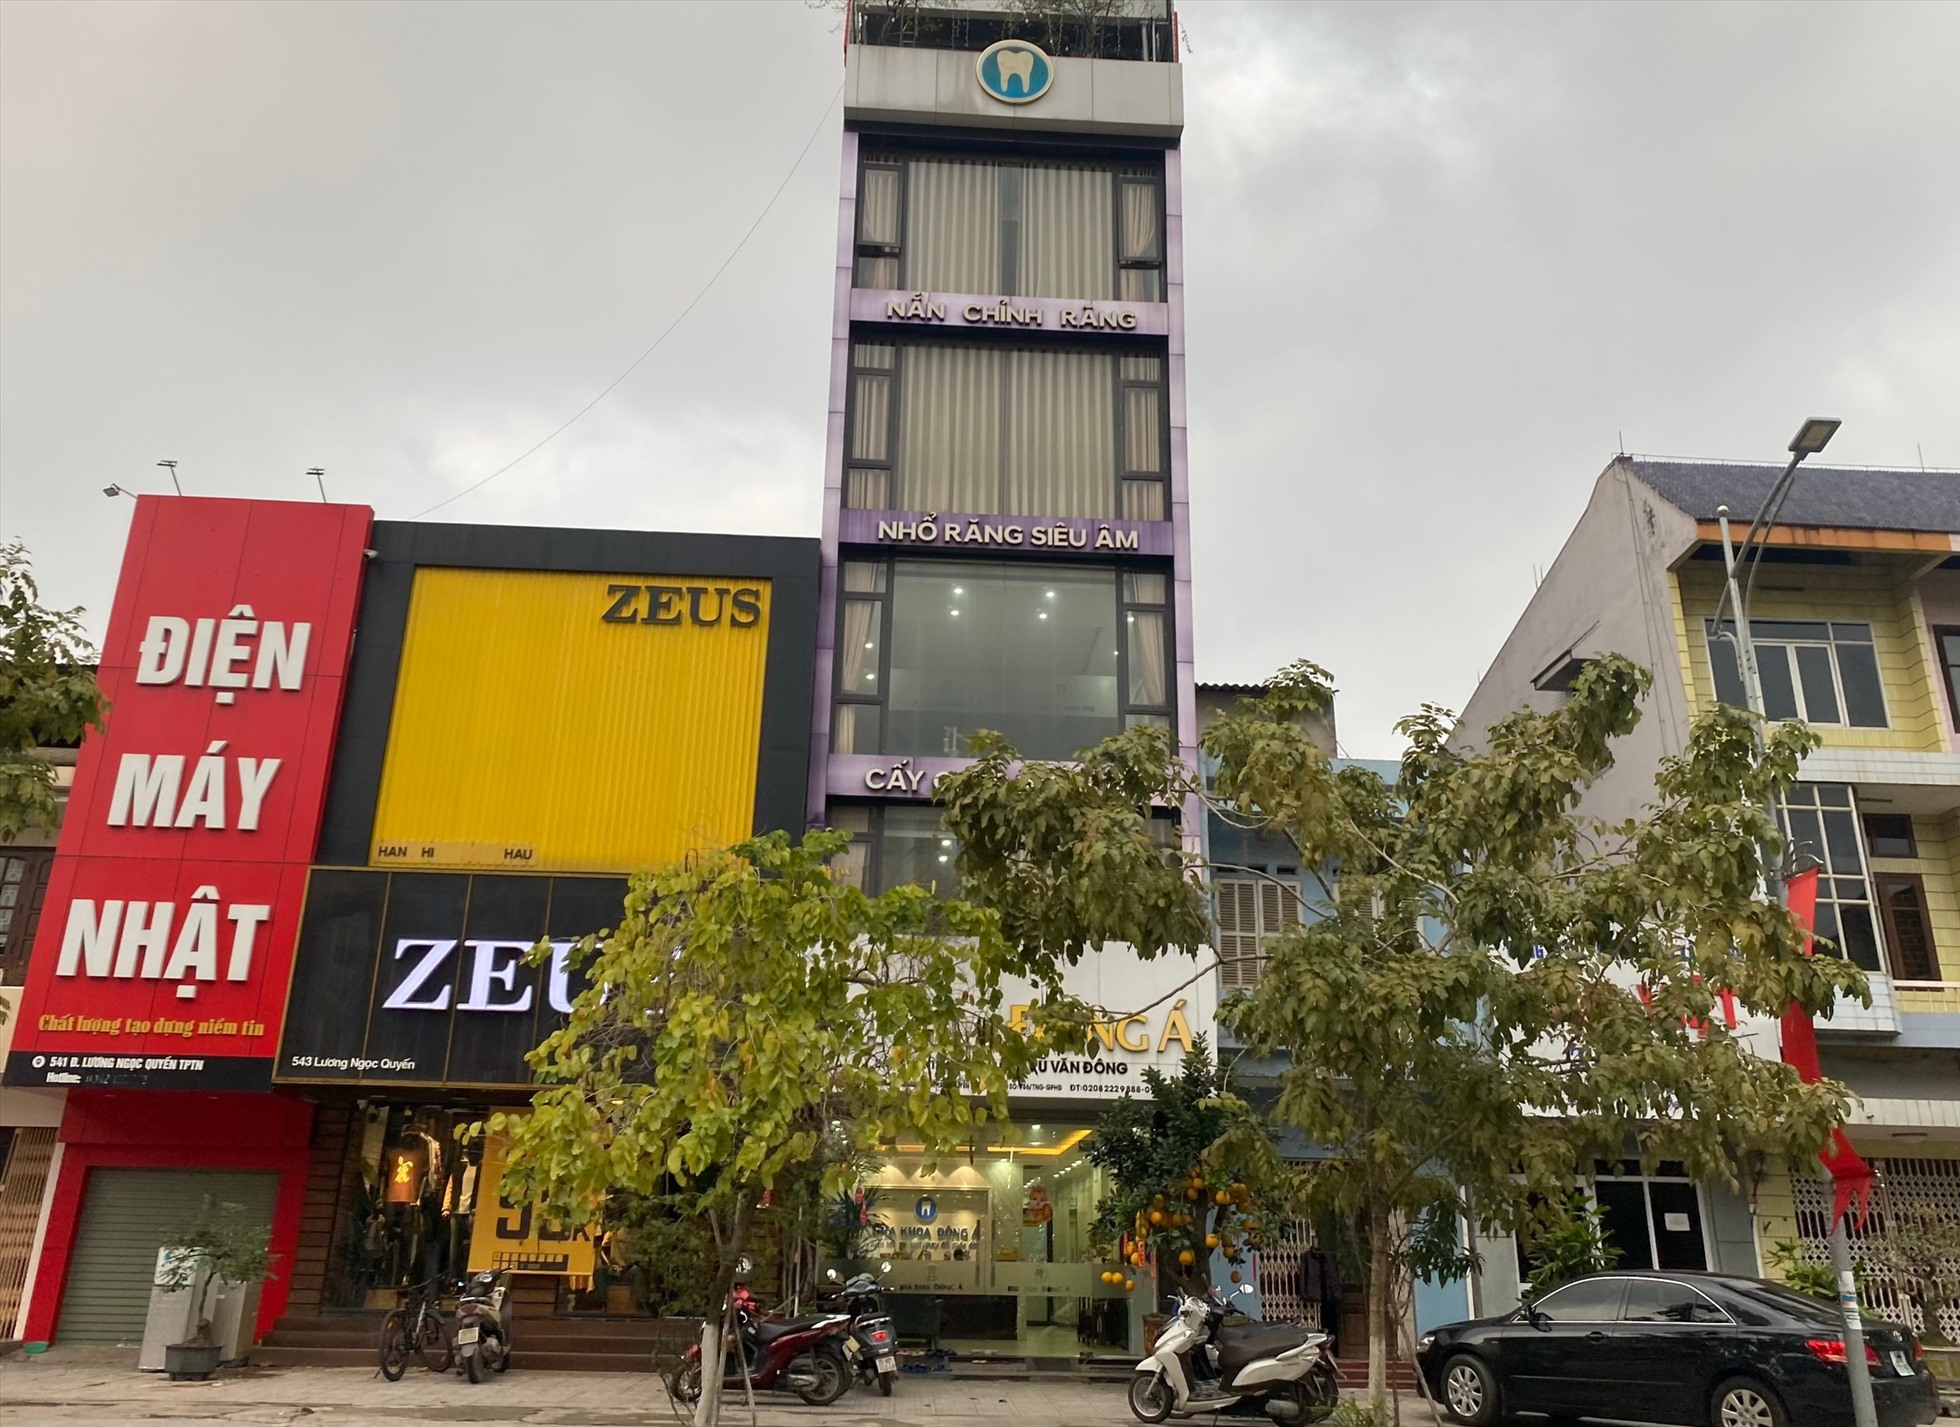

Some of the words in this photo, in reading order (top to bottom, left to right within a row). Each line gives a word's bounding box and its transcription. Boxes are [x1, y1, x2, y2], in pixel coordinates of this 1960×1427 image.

[887, 292, 945, 320] NẮN
[963, 300, 1043, 325] CHÍNH
[1061, 305, 1137, 329] RĂNG
[878, 512, 938, 541] NHỔ
[944, 518, 1023, 544] RĂNG
[1030, 522, 1087, 547] SIÊU
[1094, 524, 1138, 549] ÂM
[602, 584, 761, 627] ZEUS
[136, 604, 311, 704] ĐIỆN
[107, 740, 282, 831] MÁY
[865, 760, 925, 792] CẤY
[378, 846, 407, 858] HAN
[503, 849, 533, 860] HAU
[55, 885, 271, 998] NHẬT
[38, 1013, 74, 1031] Chất
[76, 1015, 121, 1036] lượng
[125, 1018, 151, 1036] tạo
[153, 1017, 195, 1038] dựng
[242, 1019, 264, 1036] tin
[1157, 999, 1195, 1053] Á
[50, 1056, 68, 1067] 541
[116, 1058, 144, 1071] NGỌC
[291, 1056, 312, 1067] 543
[314, 1056, 347, 1070] Lương
[350, 1058, 379, 1070] Ngọc
[1050, 1057, 1080, 1075] VĂN
[1082, 1057, 1128, 1075] ĐÔNG
